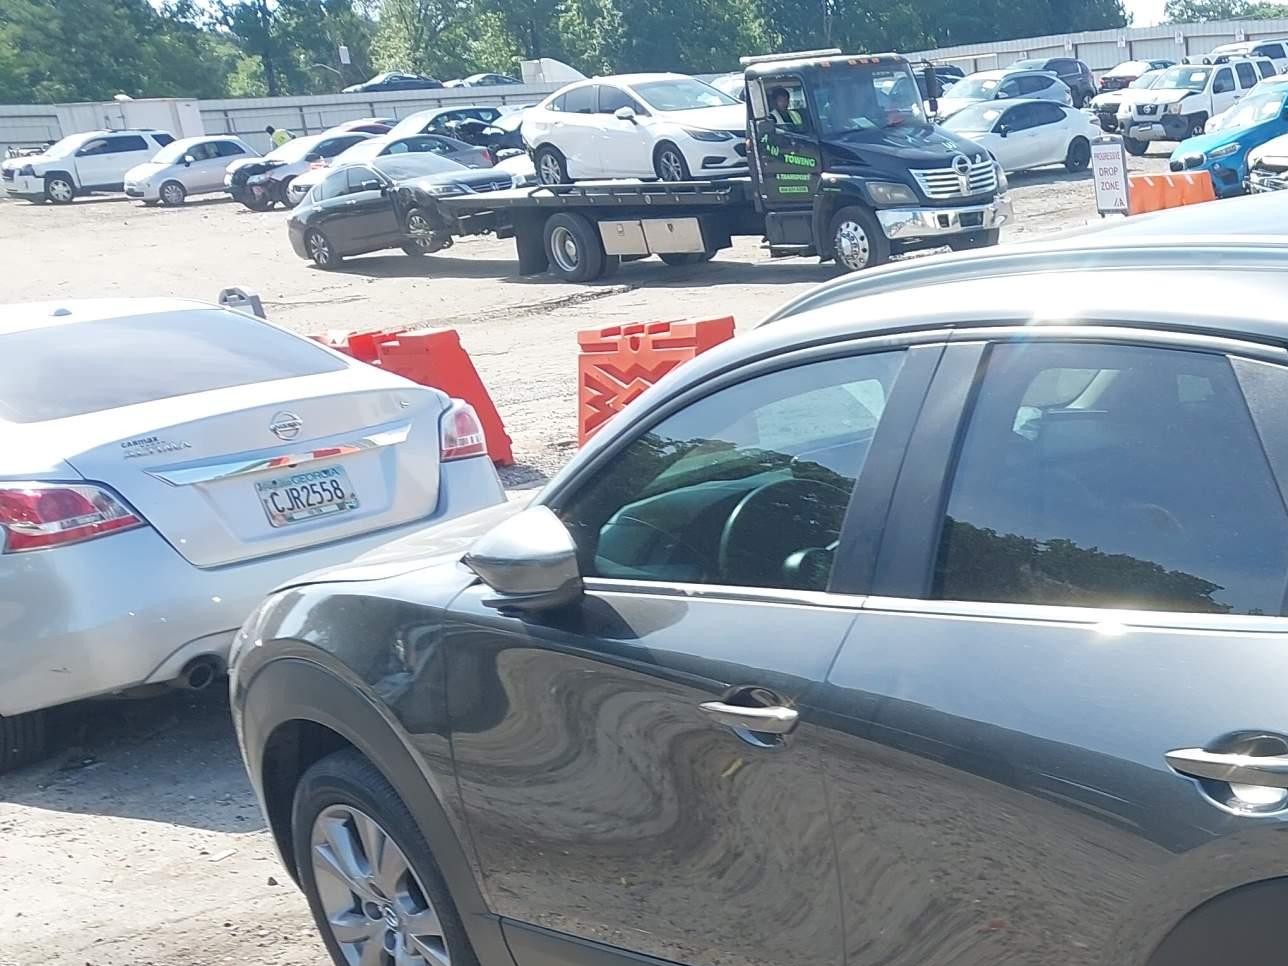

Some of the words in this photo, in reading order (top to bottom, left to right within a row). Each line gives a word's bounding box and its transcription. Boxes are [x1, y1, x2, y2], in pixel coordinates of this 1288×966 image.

[784, 153, 816, 168] TOWING
[1098, 166, 1119, 177] DROP
[1100, 181, 1120, 191] ZONE
[270, 479, 345, 513] CJR2558
